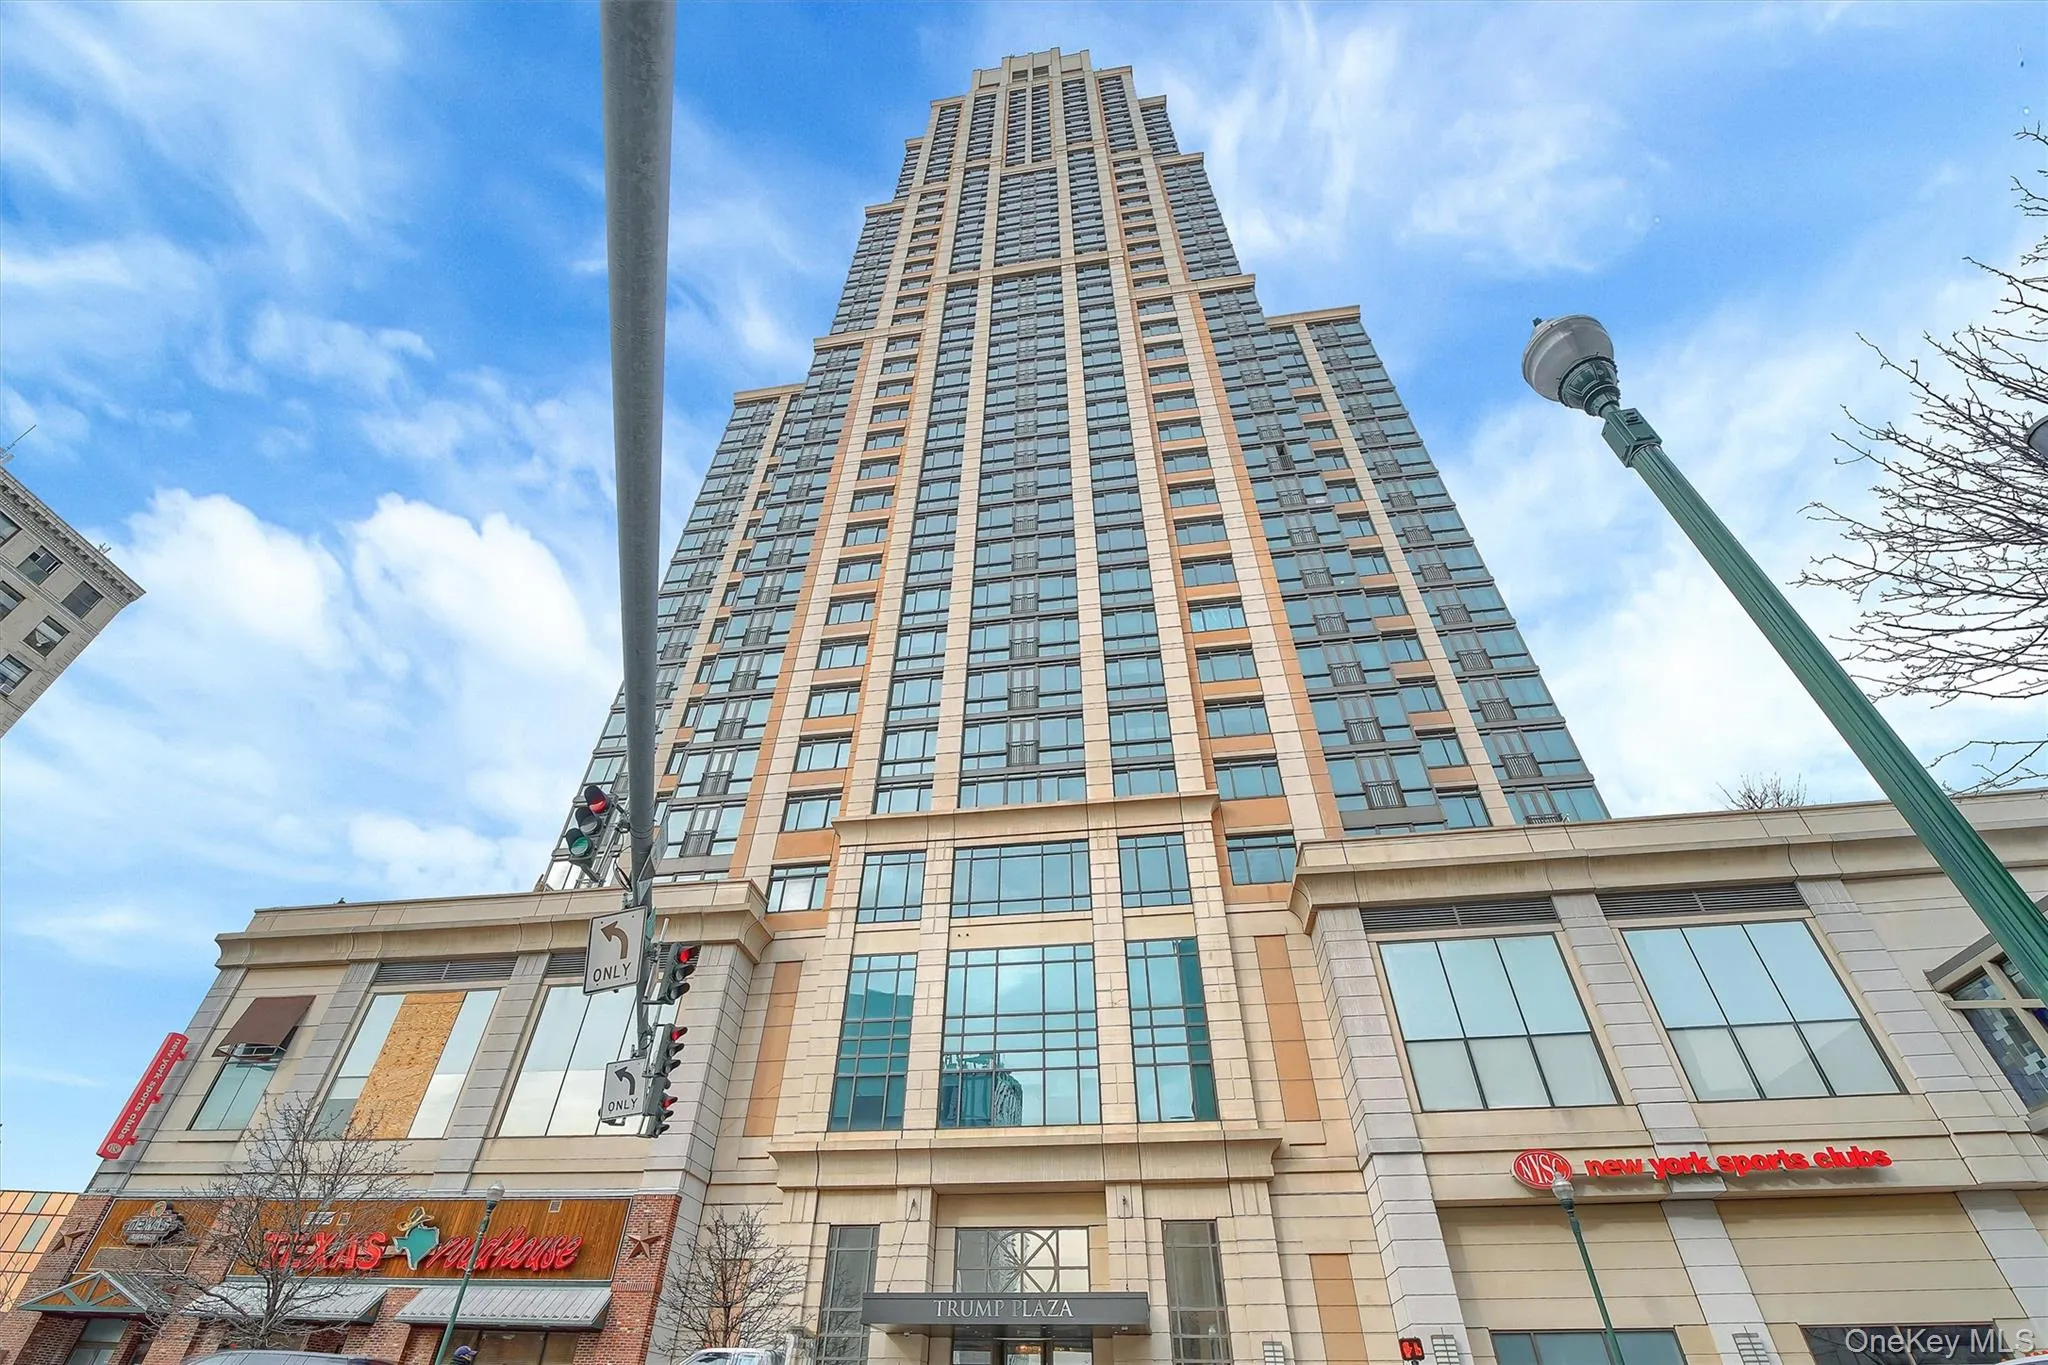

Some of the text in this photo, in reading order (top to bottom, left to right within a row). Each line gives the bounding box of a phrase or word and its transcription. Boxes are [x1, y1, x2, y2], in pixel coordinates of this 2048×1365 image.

[593, 962, 632, 983] ONLY
[135, 1081, 157, 1112] sports
[608, 1097, 638, 1112] ONLY
[117, 1113, 137, 1140] clubs
[1584, 1145, 1893, 1179] new york sports clubs
[934, 1299, 1074, 1317] TRUMP PLAZA
